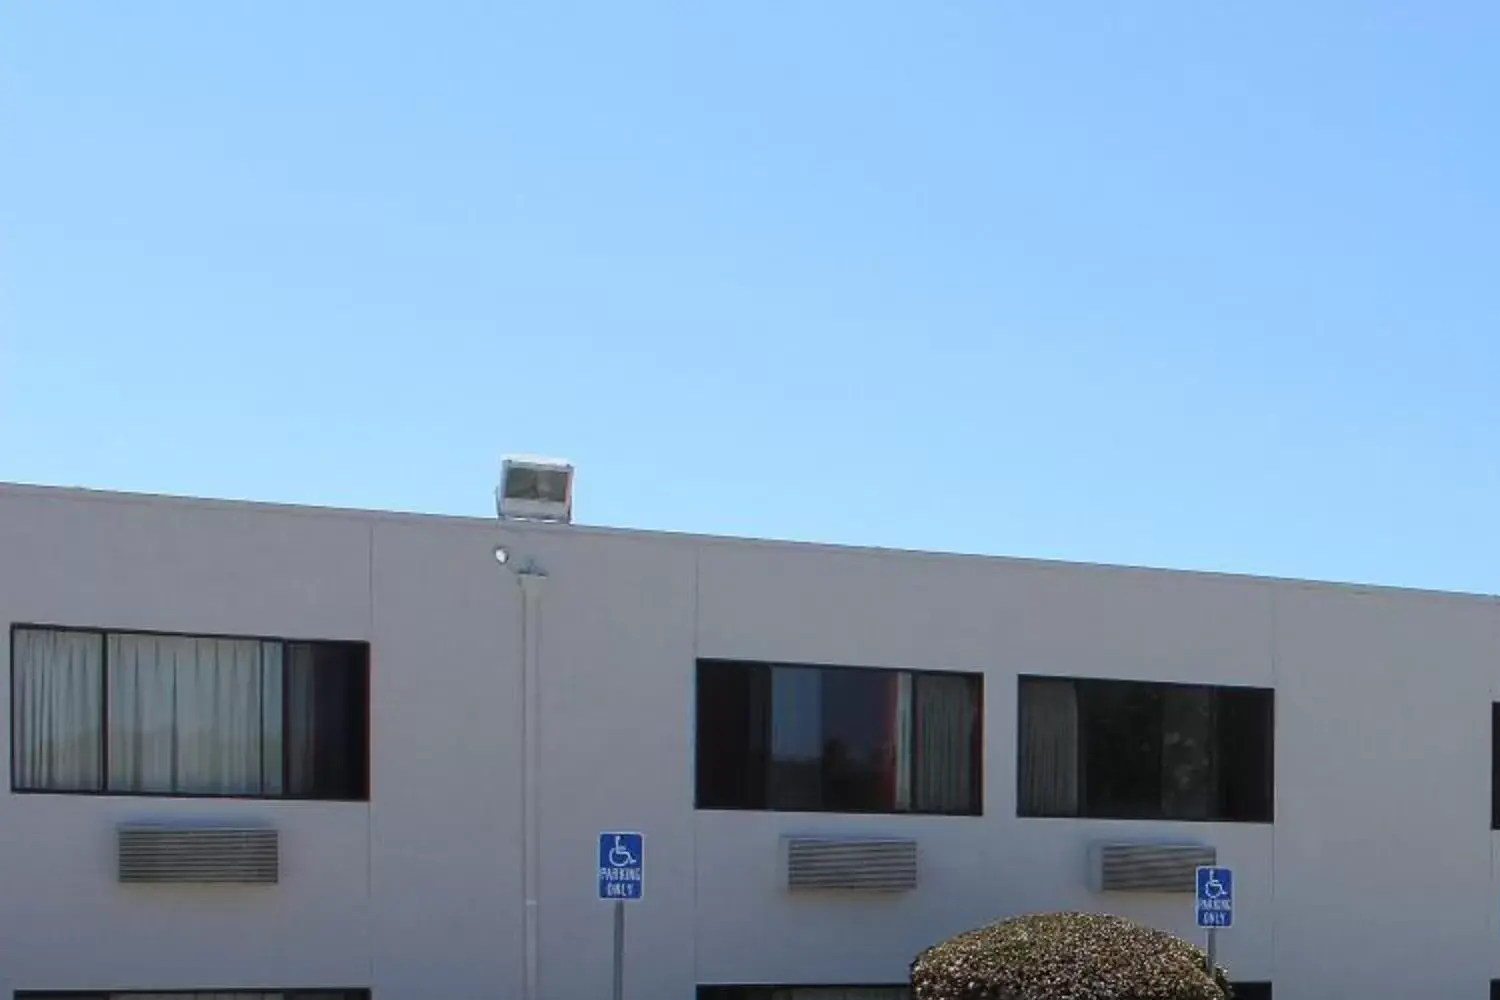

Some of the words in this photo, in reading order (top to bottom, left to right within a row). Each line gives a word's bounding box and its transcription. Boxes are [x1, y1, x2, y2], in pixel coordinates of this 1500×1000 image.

[600, 867, 640, 881] PARKING
[607, 882, 634, 897] ONLY
[1198, 898, 1231, 910] PARKING
[1203, 911, 1225, 925] ONLY
